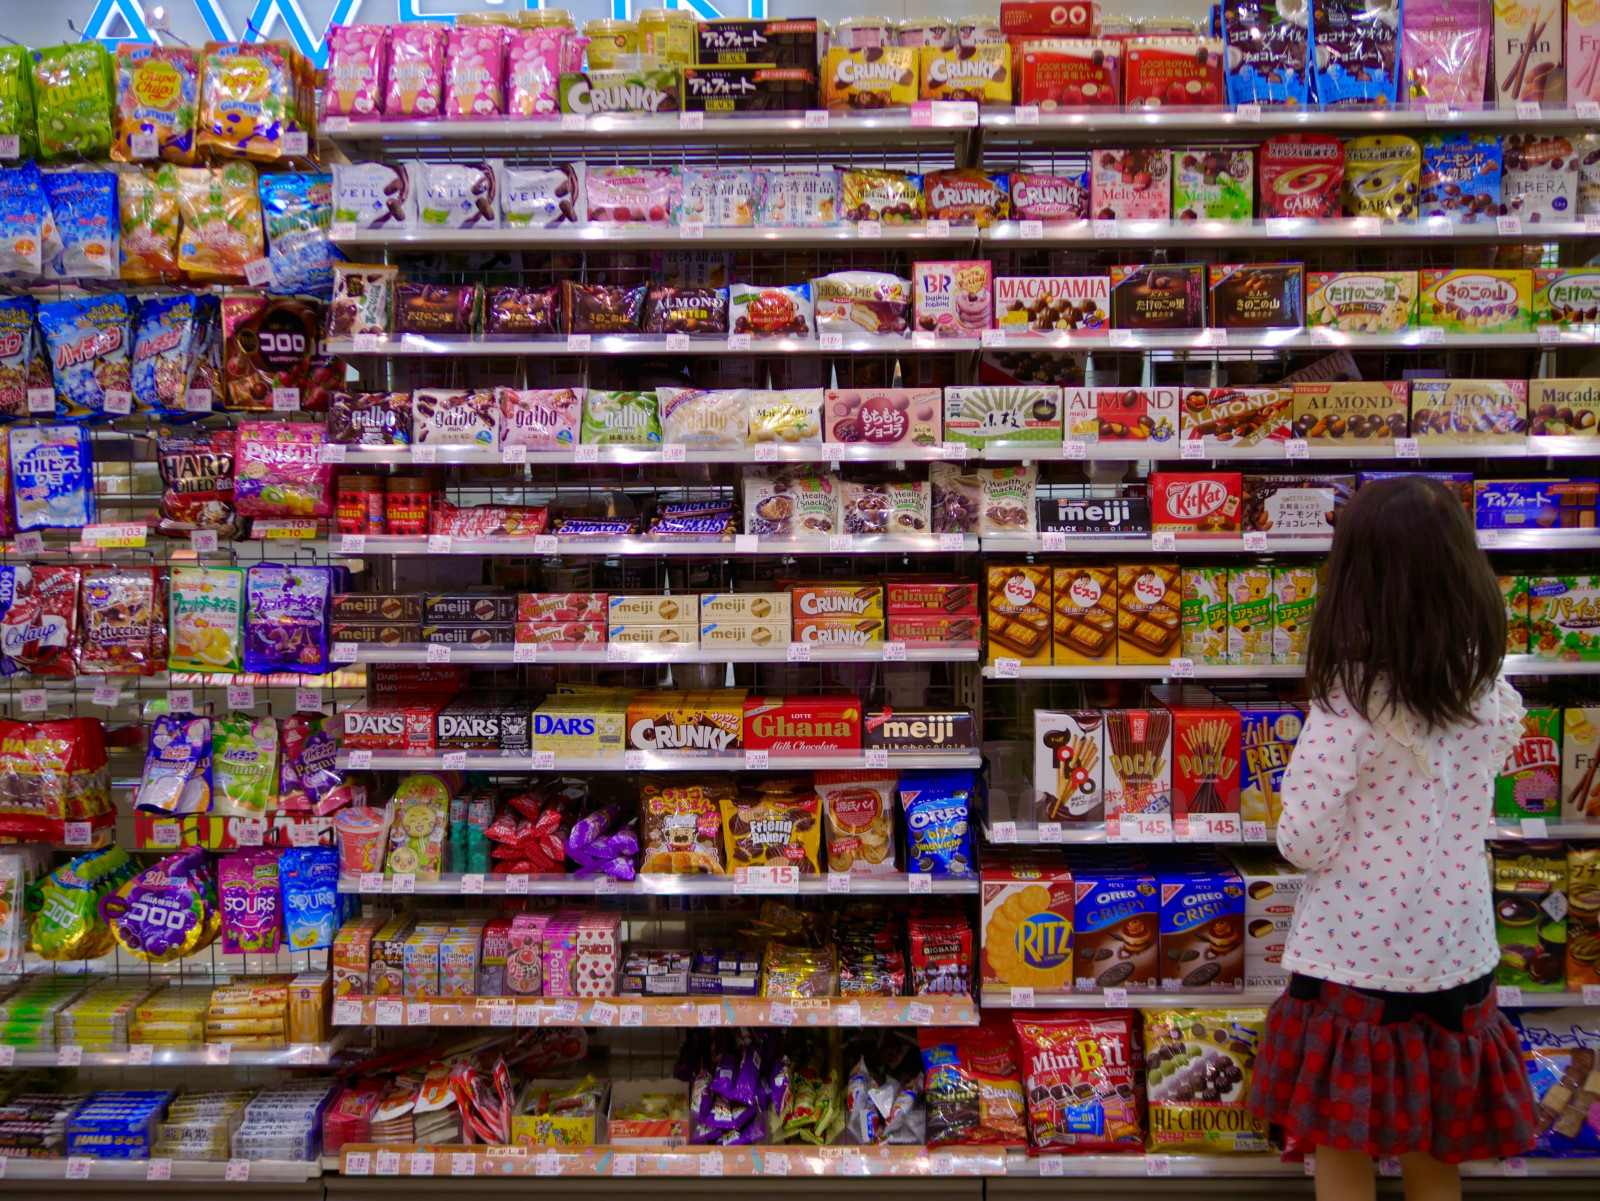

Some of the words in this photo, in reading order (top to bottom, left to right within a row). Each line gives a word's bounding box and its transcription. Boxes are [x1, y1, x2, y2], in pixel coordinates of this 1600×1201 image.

[701, 30, 768, 49] アルフォート
[718, 53, 747, 64] BLACK
[1165, 59, 1194, 69] ROYAL
[139, 69, 178, 84] Chupa
[329, 63, 374, 80] Caplico
[389, 63, 433, 80] Caplico
[446, 66, 490, 82] Caplico
[837, 59, 904, 84] CRUNKY
[929, 57, 1000, 82] CRUNKY
[136, 82, 175, 97] Chups
[689, 77, 757, 95] アルフォート
[567, 81, 668, 114] CRUNKY
[706, 100, 735, 111] BLACK
[1432, 153, 1484, 169] アーモンド
[1444, 166, 1473, 182] 効果
[340, 187, 378, 199] VEIL
[427, 187, 467, 200] VEIL
[689, 182, 752, 197] 台湾甜品
[770, 179, 835, 196] 台湾甜品
[1012, 181, 1082, 207] CRUNKY
[1101, 187, 1164, 202] Meltykiss
[1503, 181, 1568, 196] LIBERA
[509, 190, 549, 202] VEIL
[930, 184, 998, 208] CRUNKY
[1283, 198, 1319, 211] GABA
[1358, 199, 1393, 212] GABA
[922, 273, 952, 294] BR
[957, 276, 986, 289] Potion
[960, 270, 981, 281] Love
[999, 278, 1108, 299] MACADAMIA
[1328, 284, 1397, 302] たけのこの里
[1446, 283, 1508, 302] きのこの山
[655, 296, 726, 311] ALMOND
[1135, 298, 1185, 312] たけのこの里
[1235, 298, 1280, 311] きのこの山
[588, 313, 630, 325] きのこの山
[669, 310, 708, 321] BITTER
[1069, 389, 1175, 411] ALMOND
[1307, 396, 1394, 410] ALMOND
[1426, 393, 1514, 408] ALMOND
[352, 405, 397, 430] galbo
[435, 405, 477, 429] galbo
[515, 405, 558, 429] galbo
[604, 405, 649, 430] galbo
[861, 408, 905, 425] もちもち
[1181, 391, 1282, 432] ALMOND
[608, 433, 643, 442] 抹茶ミルク
[863, 424, 904, 439] ショコラ
[1249, 414, 1290, 446] PEAK
[18, 458, 82, 475] カルピス
[161, 453, 235, 479] HARD
[34, 471, 63, 486] グミ
[988, 478, 1027, 489] Healthy
[802, 491, 834, 503] Healthy
[1175, 480, 1221, 517] KitKat
[1256, 488, 1276, 500] ビター
[1483, 491, 1552, 508] アルフォート
[666, 501, 732, 513] SNICKERS
[799, 499, 835, 510] Snacking
[1057, 500, 1131, 525] meiji
[386, 508, 426, 521] Ghana
[1278, 510, 1321, 520] アーモンド
[290, 519, 312, 530] 103
[1047, 525, 1077, 533] BLACK
[1078, 525, 1143, 533] chocolate
[1276, 519, 1323, 529] チョコレート
[119, 527, 143, 538] 103
[1006, 582, 1034, 600] ビスコ
[1071, 584, 1100, 601] ビスコ
[1136, 580, 1163, 597] ビスコ
[172, 592, 239, 614] フェットチーネグミ
[800, 592, 871, 616] CRUNKY
[889, 588, 944, 606] Ghana
[340, 599, 378, 614] meiji
[433, 600, 471, 616] meiji
[522, 600, 565, 619] Strawberry
[618, 601, 654, 615] meiji
[1233, 604, 1268, 620] コアラのマーチ
[338, 627, 376, 642] meiji
[430, 627, 468, 643] meiji
[801, 624, 873, 647] CRUNKY
[891, 621, 946, 638] Ghana
[344, 714, 405, 736] DARS
[534, 714, 595, 736] DARS
[710, 712, 740, 723] サクサク
[437, 715, 499, 738] DARS
[629, 718, 739, 751] CRUNKY
[751, 713, 852, 740] Ghana
[769, 741, 790, 751] Milk
[791, 741, 838, 751] Chocolate
[901, 742, 966, 751] chocolate
[1108, 751, 1168, 779] POCKY
[1178, 750, 1239, 780] POCKY
[662, 788, 702, 801] チョコ
[835, 799, 875, 813] 源氏パイ
[909, 806, 968, 829] OREO
[749, 819, 793, 834] Friend
[1137, 820, 1167, 835] 145
[1205, 820, 1235, 834] 145
[751, 832, 791, 846] Bakery
[223, 896, 276, 911] SOURS
[287, 892, 336, 909] SOURS
[1095, 889, 1137, 906] OREO
[1181, 890, 1224, 908] OREO
[1086, 899, 1146, 927] CRISPY
[1172, 899, 1233, 928] CRISPY
[484, 937, 508, 946] CHOCO
[578, 943, 612, 955] アポロ
[1018, 919, 1075, 963] RITZ
[485, 947, 507, 957] BABY
[375, 962, 384, 970] 50
[507, 964, 540, 980] グミチョコ
[549, 949, 564, 997] Poifull
[347, 1005, 358, 1013] 77
[387, 1005, 398, 1013] 77
[1031, 1053, 1079, 1074] Mini
[1077, 1037, 1126, 1074] Bit
[1102, 1065, 1132, 1078] Assort
[73, 1134, 114, 1146] HALLS
[164, 1129, 210, 1143] 龍角散
